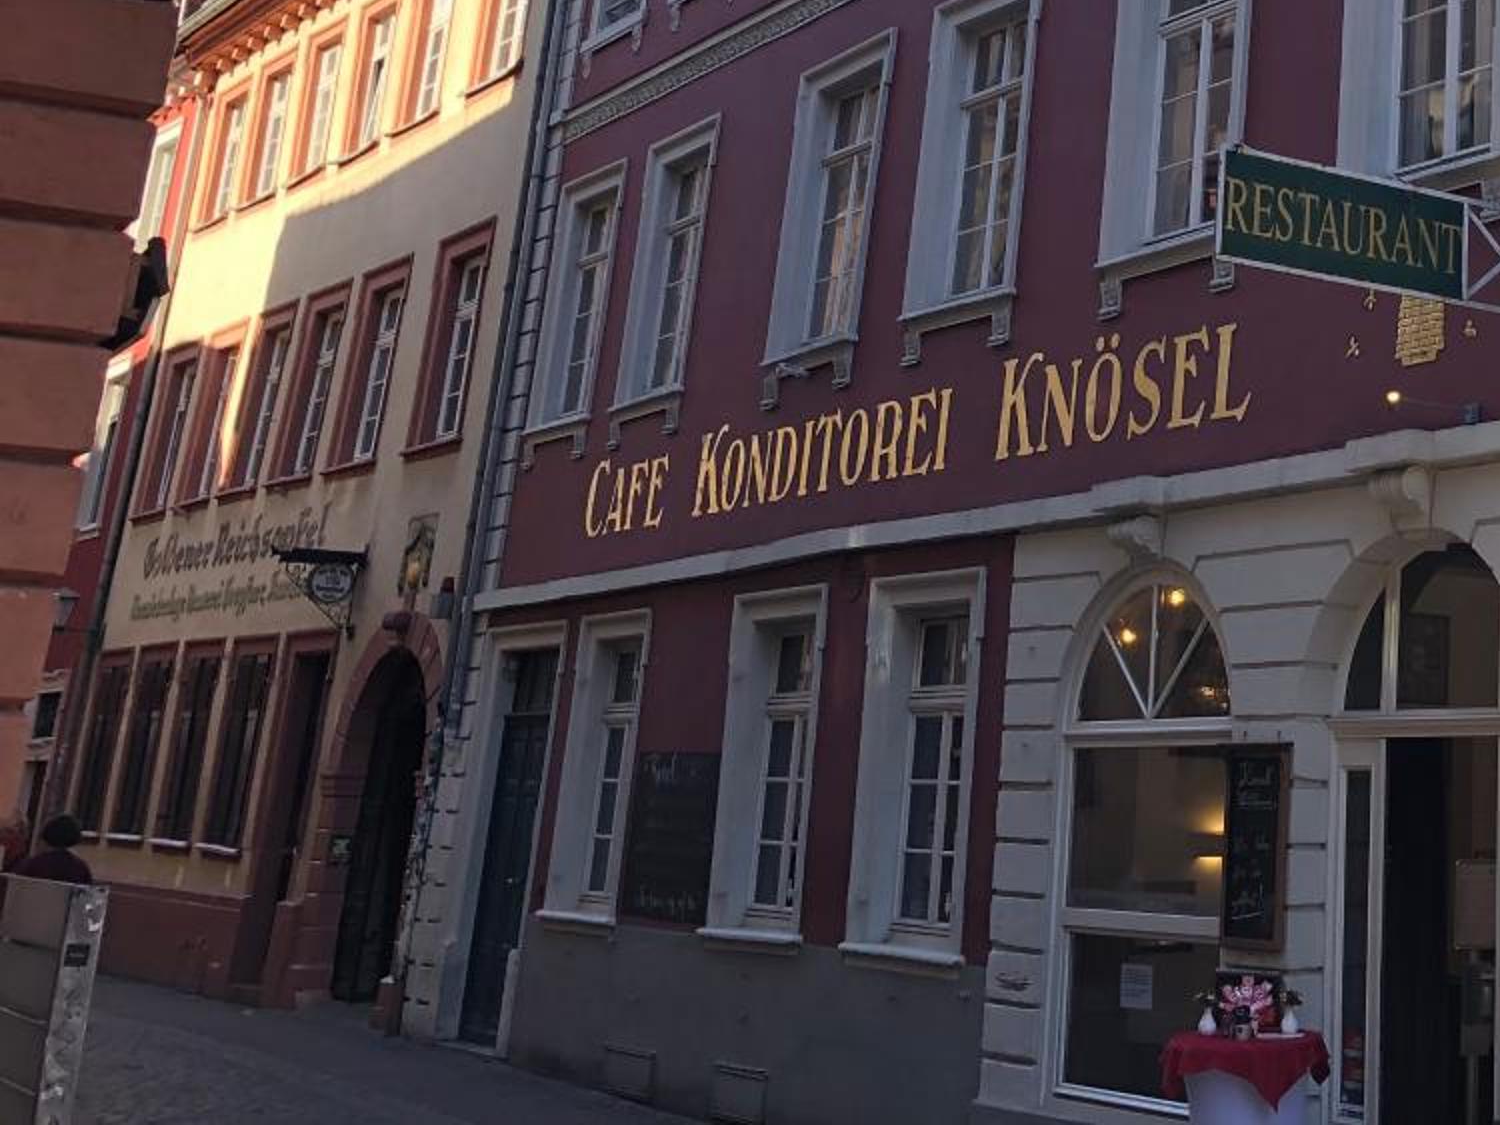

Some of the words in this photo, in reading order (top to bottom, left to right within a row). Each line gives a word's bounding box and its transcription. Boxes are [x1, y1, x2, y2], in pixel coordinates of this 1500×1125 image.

[1225, 177, 1464, 274] RESTAURANT
[584, 457, 670, 538] CAFE
[692, 387, 953, 518] KONDITOREI
[994, 323, 1252, 463] KNÖSEL
